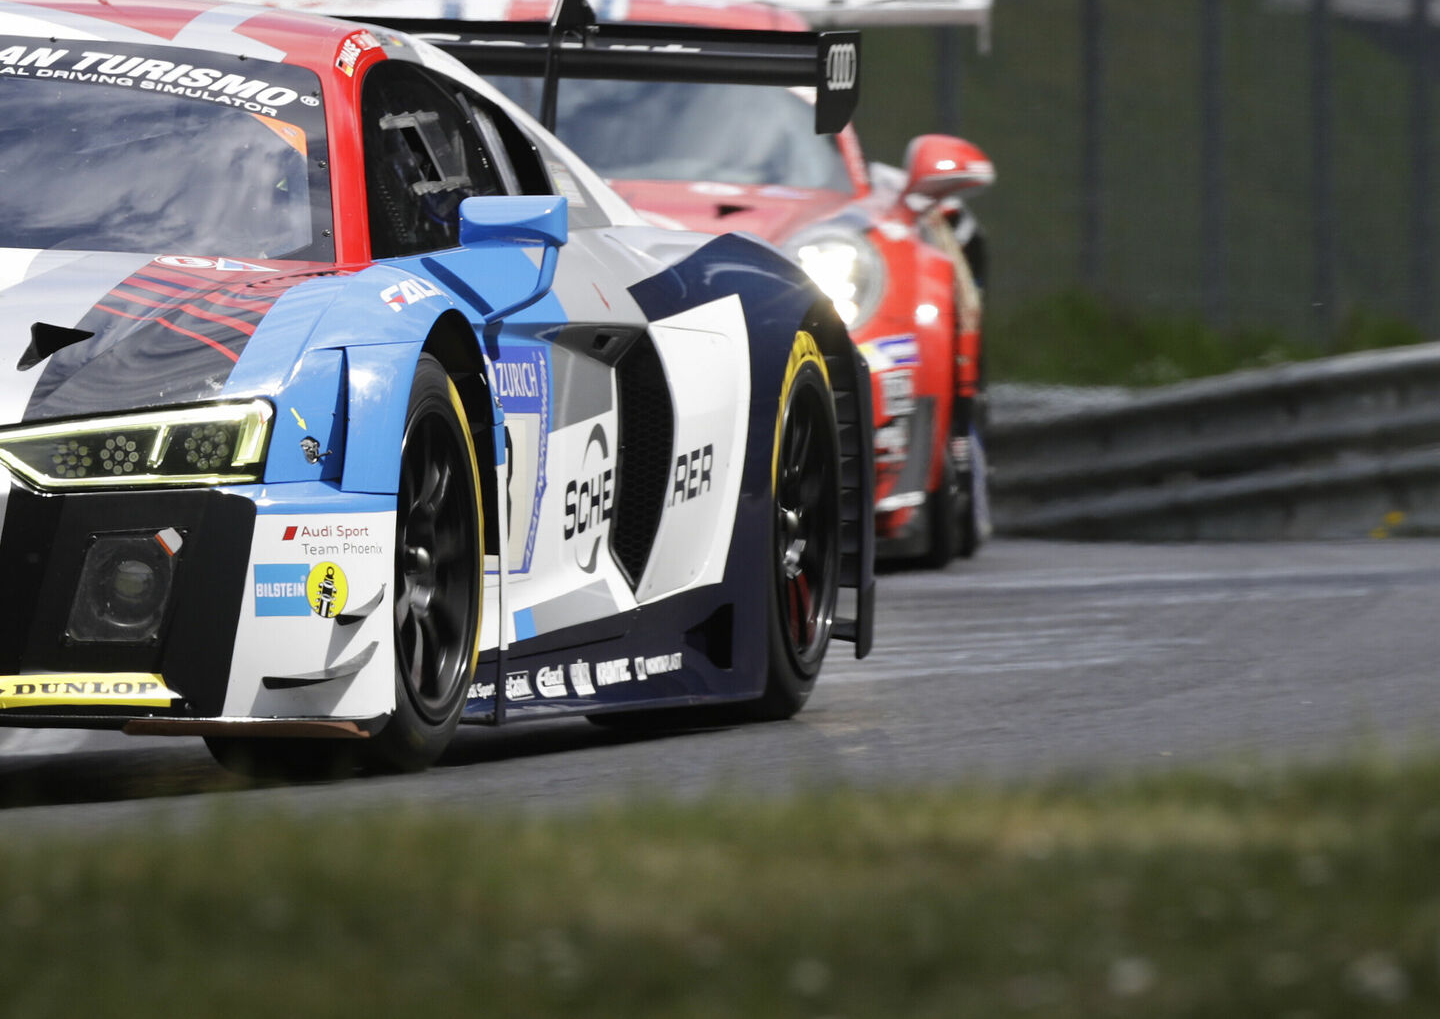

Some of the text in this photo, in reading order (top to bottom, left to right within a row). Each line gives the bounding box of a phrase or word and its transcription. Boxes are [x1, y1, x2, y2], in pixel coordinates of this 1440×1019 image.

[71, 51, 299, 107] TURISMO
[35, 68, 134, 86] DRIVING
[139, 80, 278, 117] SIMULATOR
[496, 362, 539, 397] ZURICH
[301, 525, 369, 539] Audi Sport
[302, 543, 383, 555] Team Phoenix
[256, 582, 306, 598] BILSTEIN
[13, 682, 158, 695] DUNLOP
